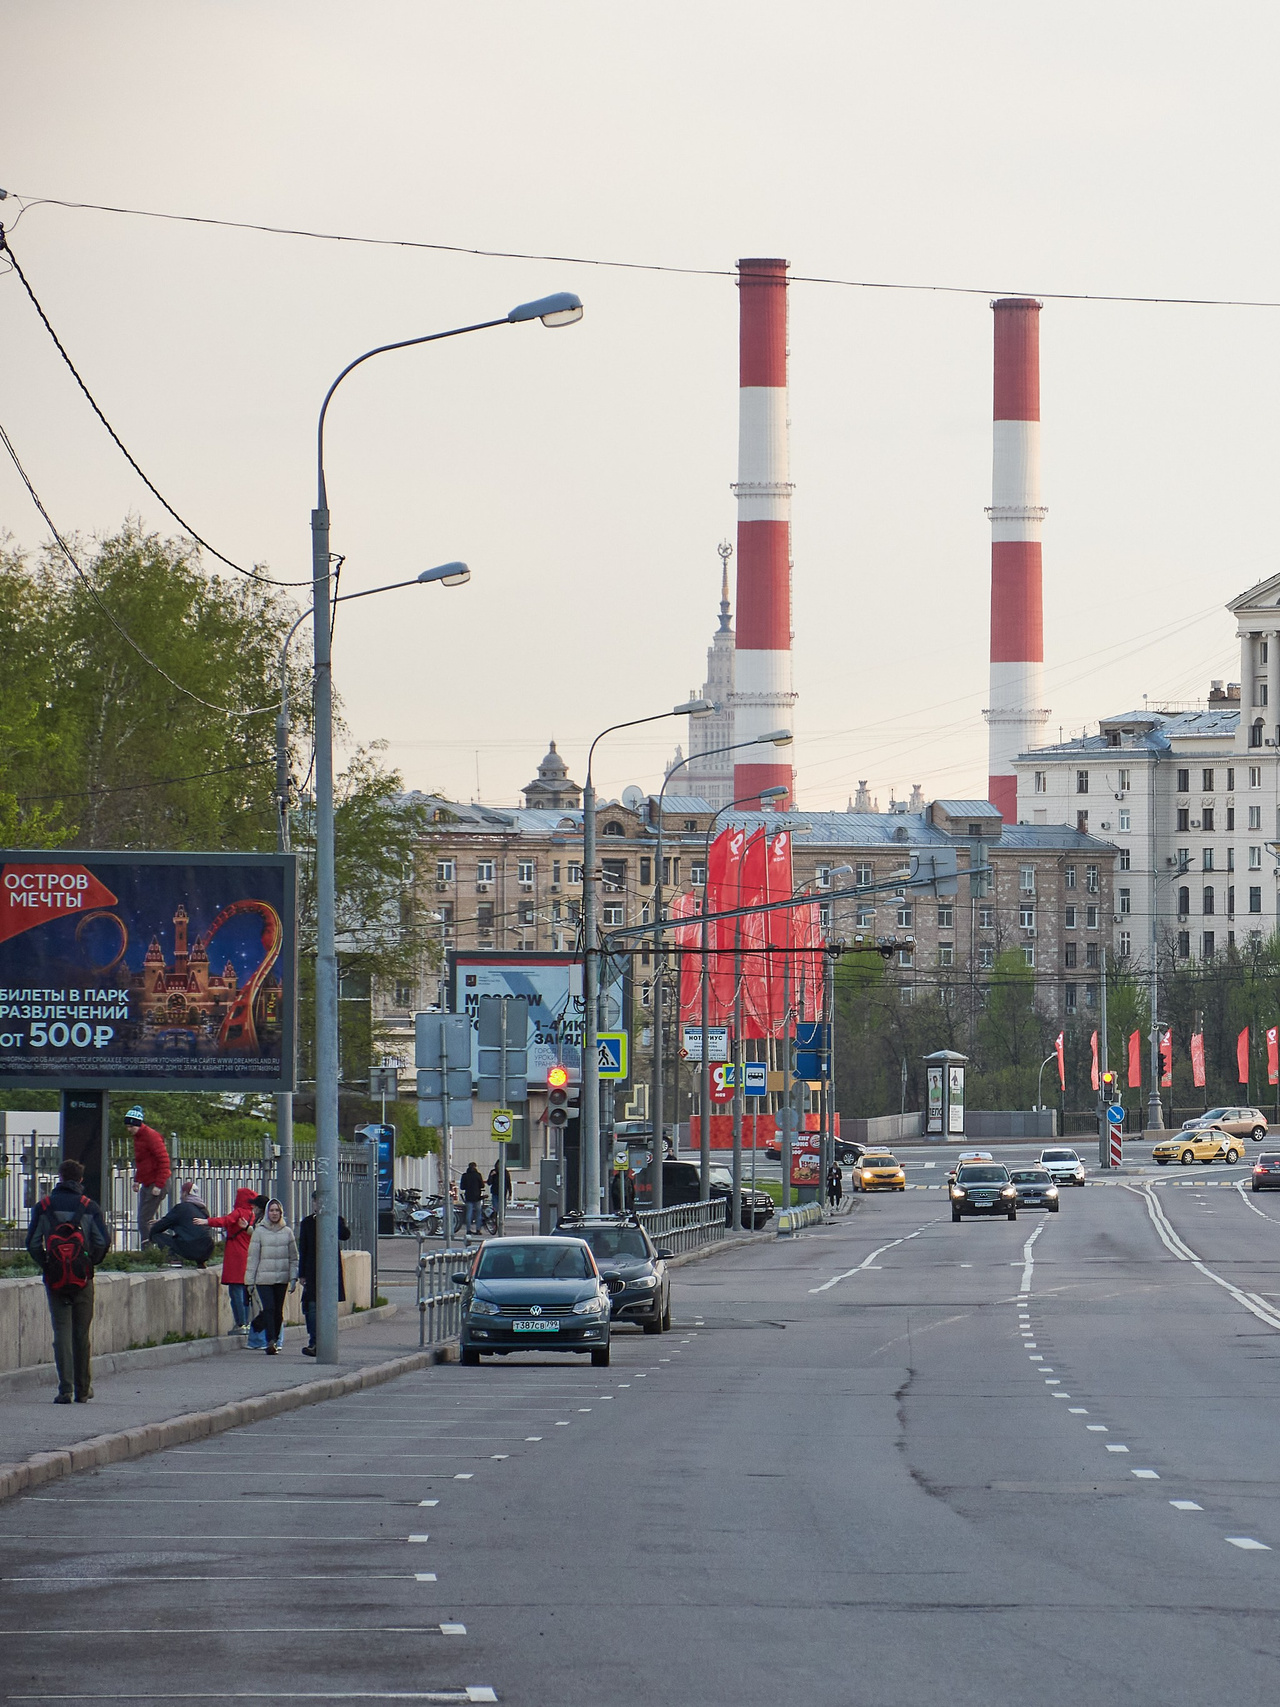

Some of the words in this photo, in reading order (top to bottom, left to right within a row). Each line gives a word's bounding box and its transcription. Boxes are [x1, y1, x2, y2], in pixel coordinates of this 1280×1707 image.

[4, 874, 88, 889] ОСТРОВ
[10, 892, 82, 907] МЕЧТЫ
[0, 989, 64, 1001] БИЛЕТЫ
[69, 990, 80, 1001] В
[85, 990, 129, 1002] ПАРК
[0, 1002, 128, 1019] РАЗВЛЕЧЕНИЙ
[29, 1022, 114, 1048] 500₽
[713, 1067, 724, 1091] 9
